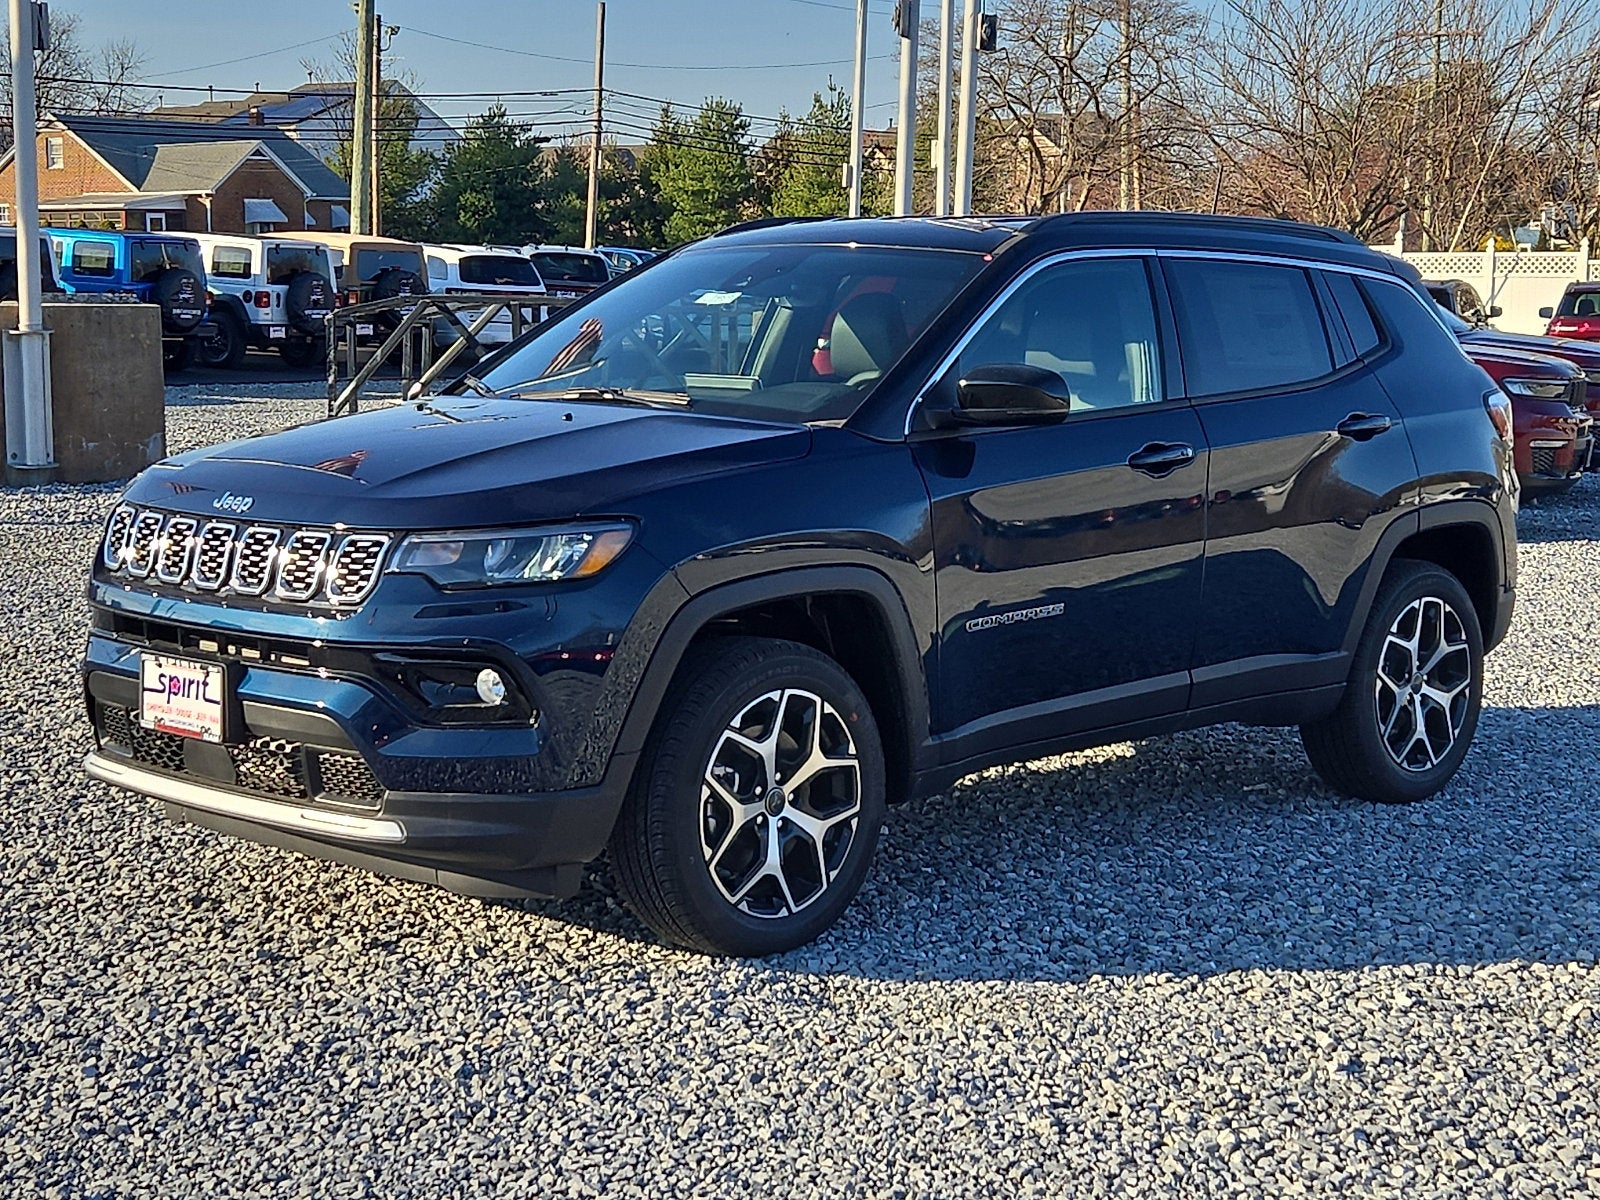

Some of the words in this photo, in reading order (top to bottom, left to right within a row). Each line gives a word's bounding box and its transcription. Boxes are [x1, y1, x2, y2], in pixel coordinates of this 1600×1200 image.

[212, 491, 253, 513] Jeep
[966, 603, 1065, 632] COMPASS
[144, 671, 221, 705] spirit
